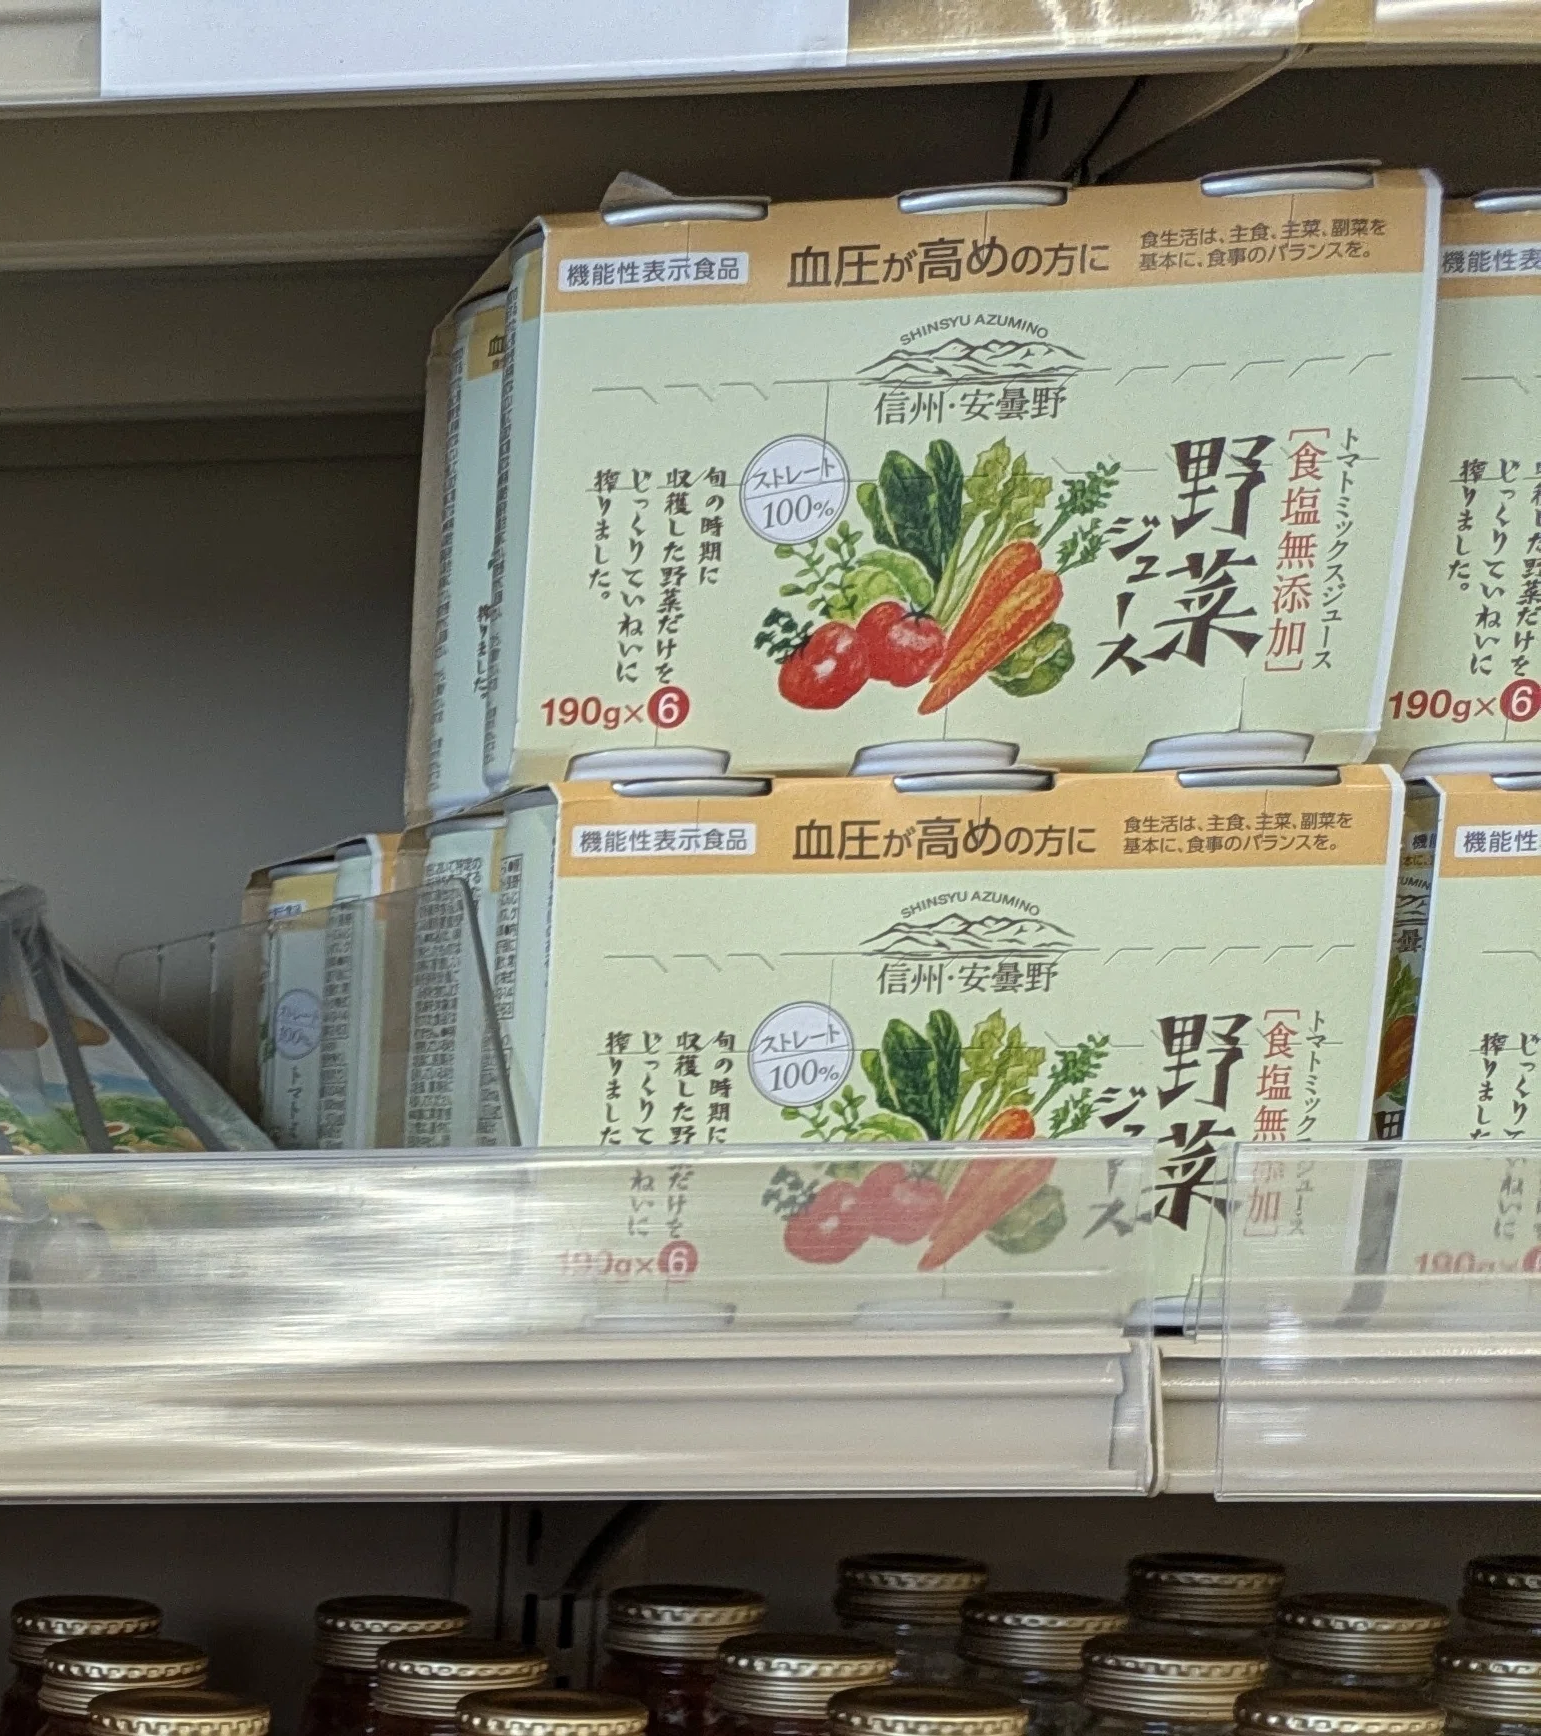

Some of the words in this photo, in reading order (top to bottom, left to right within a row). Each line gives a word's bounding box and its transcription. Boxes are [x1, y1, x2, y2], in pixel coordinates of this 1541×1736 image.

[1139, 218, 1386, 249] 食生活は、主食、主菜、副菜を
[567, 256, 740, 286] 機能性表示食品
[787, 235, 1109, 290] 血圧が高めの方に
[1139, 243, 1373, 270] 基本に、食事のバランスを。
[900, 315, 970, 346] SHINSYU
[974, 314, 1049, 339] AZUMINO
[874, 387, 1067, 426] 信州・安曇野
[752, 456, 836, 491] ストレート
[589, 469, 621, 600] 搾りました。
[698, 466, 727, 586] 旬の時期に
[763, 500, 834, 530] 100%
[1447, 458, 1484, 594] 搾りました。
[1145, 435, 1276, 667] 野菜
[1311, 428, 1359, 670] トマトミックスジュース
[1470, 458, 1520, 676] じっくりていねいに
[617, 469, 652, 682] じっくりていねいに
[655, 468, 692, 685] 収穫した野菜だけを
[1092, 515, 1160, 680] ジュース
[579, 828, 748, 853] 機能性表示食品
[792, 815, 1097, 861] 血圧が高めの方に
[1124, 812, 1352, 833] 食生活は、主食、主菜、副菜を
[1122, 832, 1338, 855] 基本に、食事のバランスを。
[901, 890, 967, 918] SHINSYU
[971, 890, 1040, 916] AZUMINO
[877, 961, 1058, 996] 信州・安曇野
[761, 1024, 842, 1053] ストレート
[708, 1030, 735, 1144] 旬の時期に
[768, 1059, 839, 1092] 100%
[1154, 1013, 1252, 1231] 野菜
